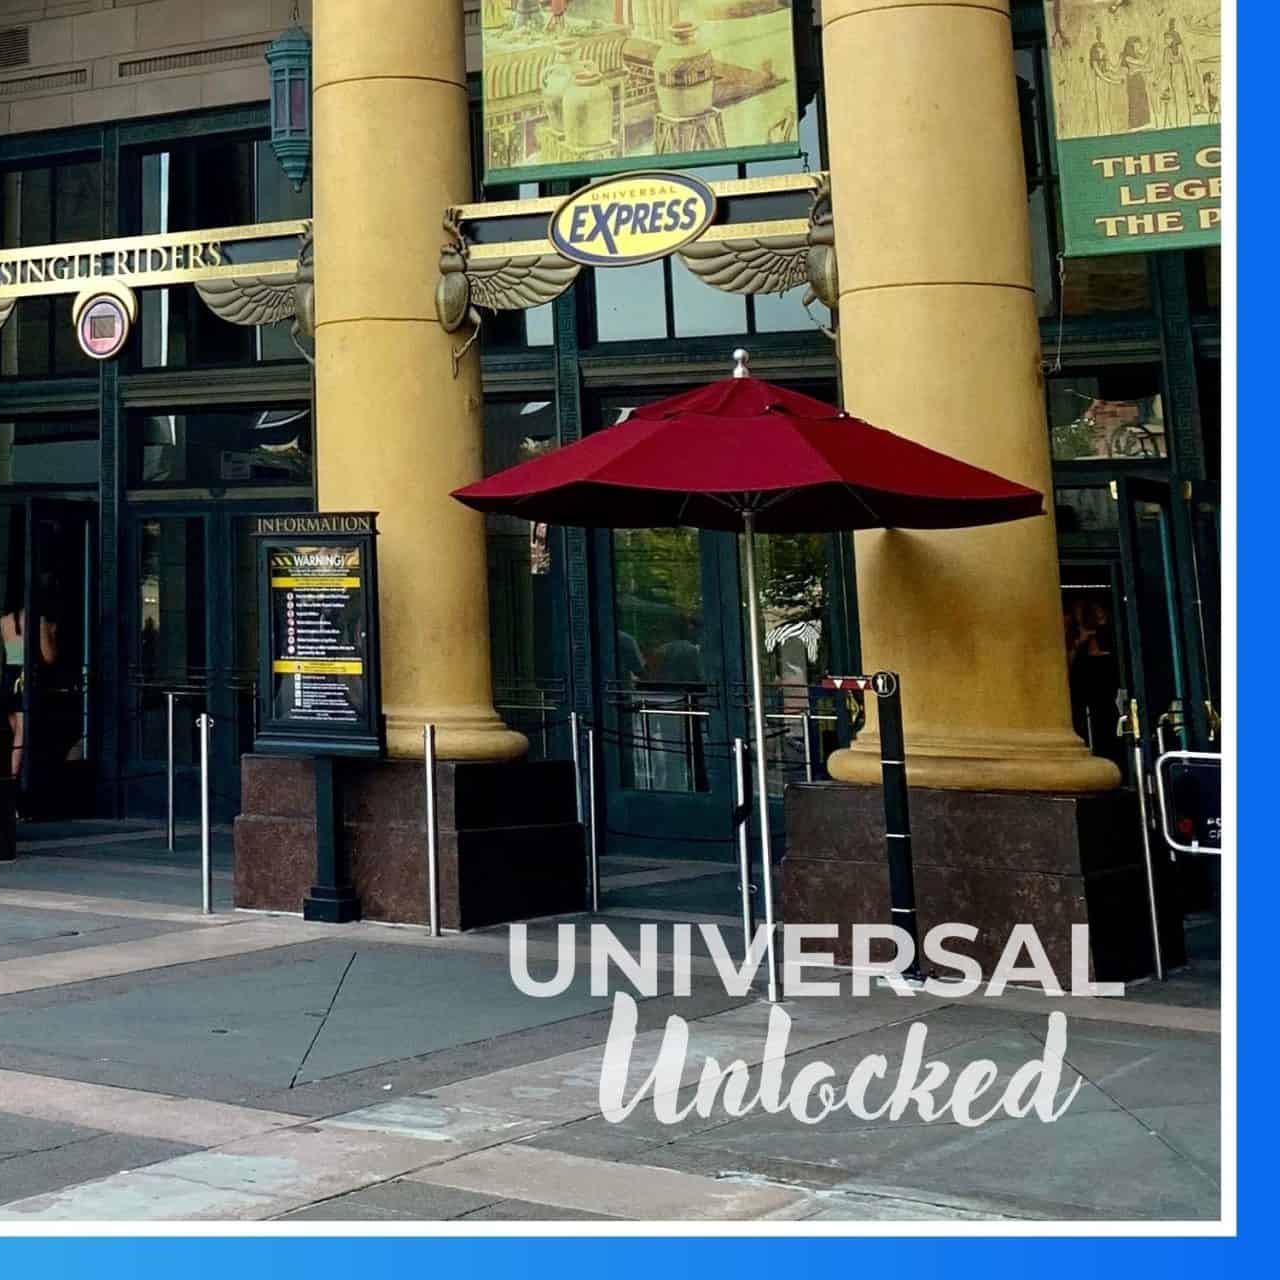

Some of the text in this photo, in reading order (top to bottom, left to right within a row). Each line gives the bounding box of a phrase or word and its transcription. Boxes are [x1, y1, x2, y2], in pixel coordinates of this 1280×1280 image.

[1091, 151, 1180, 178] THE
[591, 185, 678, 201] UNIVERSAL
[569, 196, 698, 254] EXPRESS
[1095, 211, 1184, 238] THE
[0, 241, 221, 286] SINGLE RIDERS
[257, 517, 370, 532] INFORMATION
